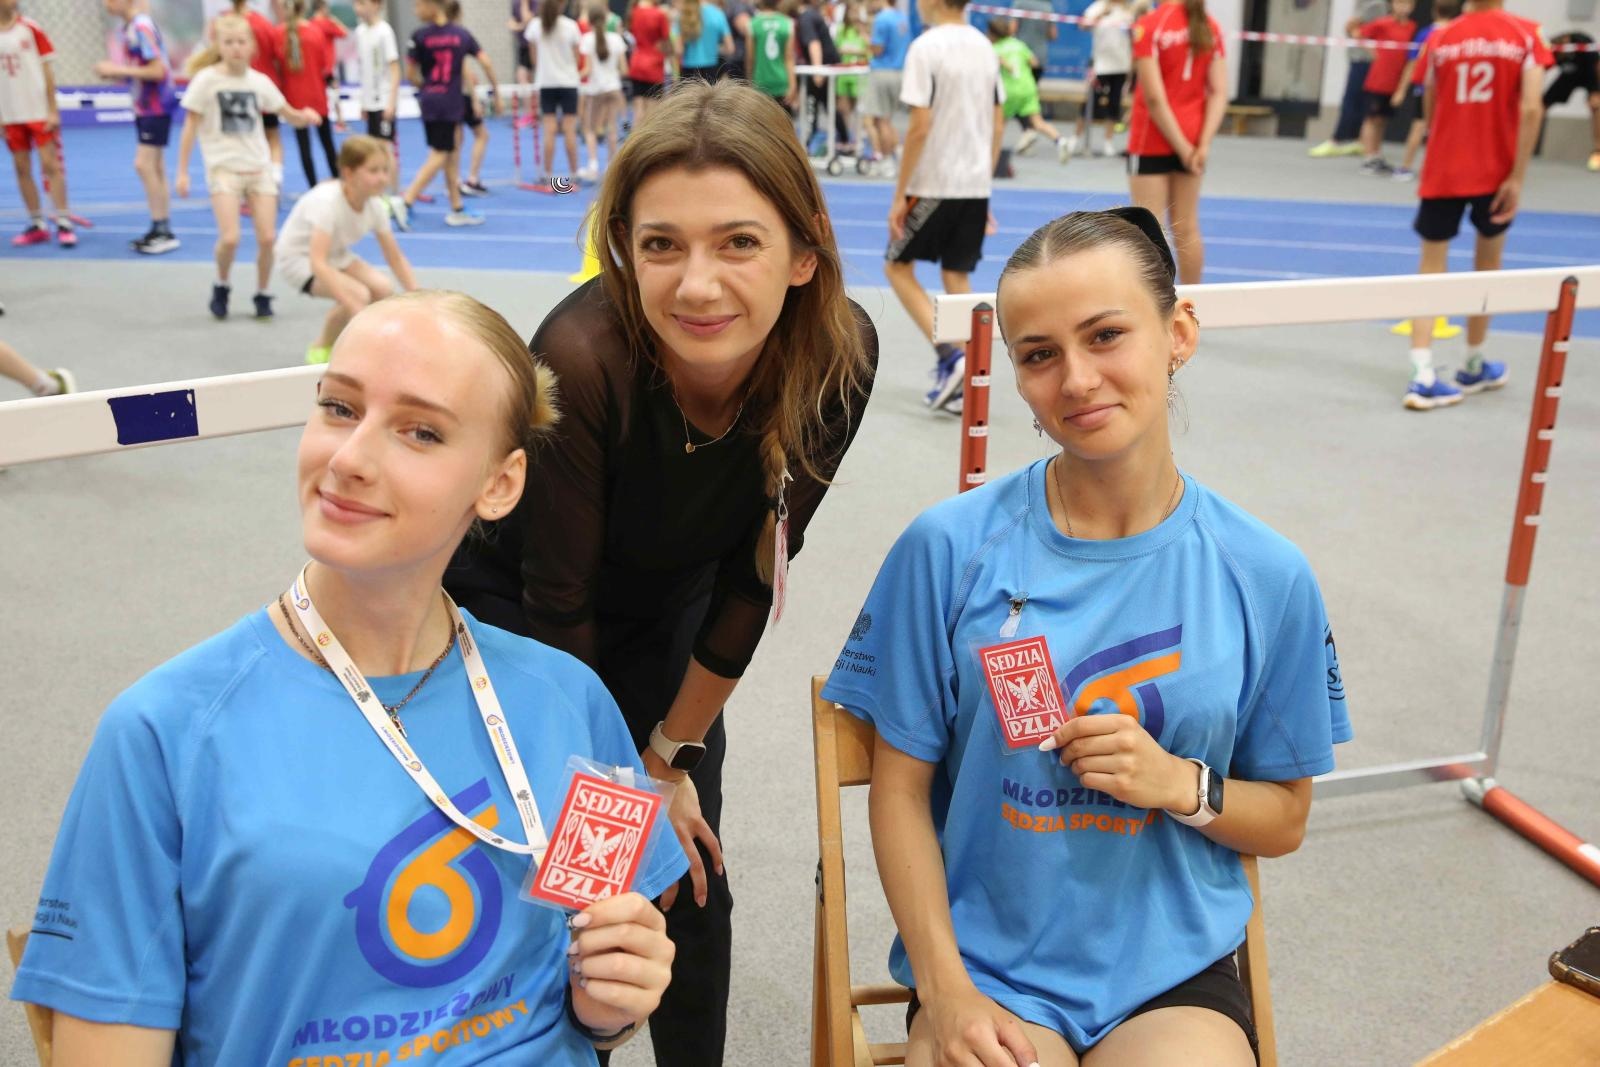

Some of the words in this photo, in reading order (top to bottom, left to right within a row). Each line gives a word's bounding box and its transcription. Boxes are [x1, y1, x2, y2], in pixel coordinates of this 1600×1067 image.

[1455, 60, 1496, 105] 12
[850, 663, 877, 677] Nauki
[1008, 713, 1061, 737] PZLA
[545, 867, 613, 900] PZLA
[292, 972, 515, 1049] MŁODZIEŻOWY
